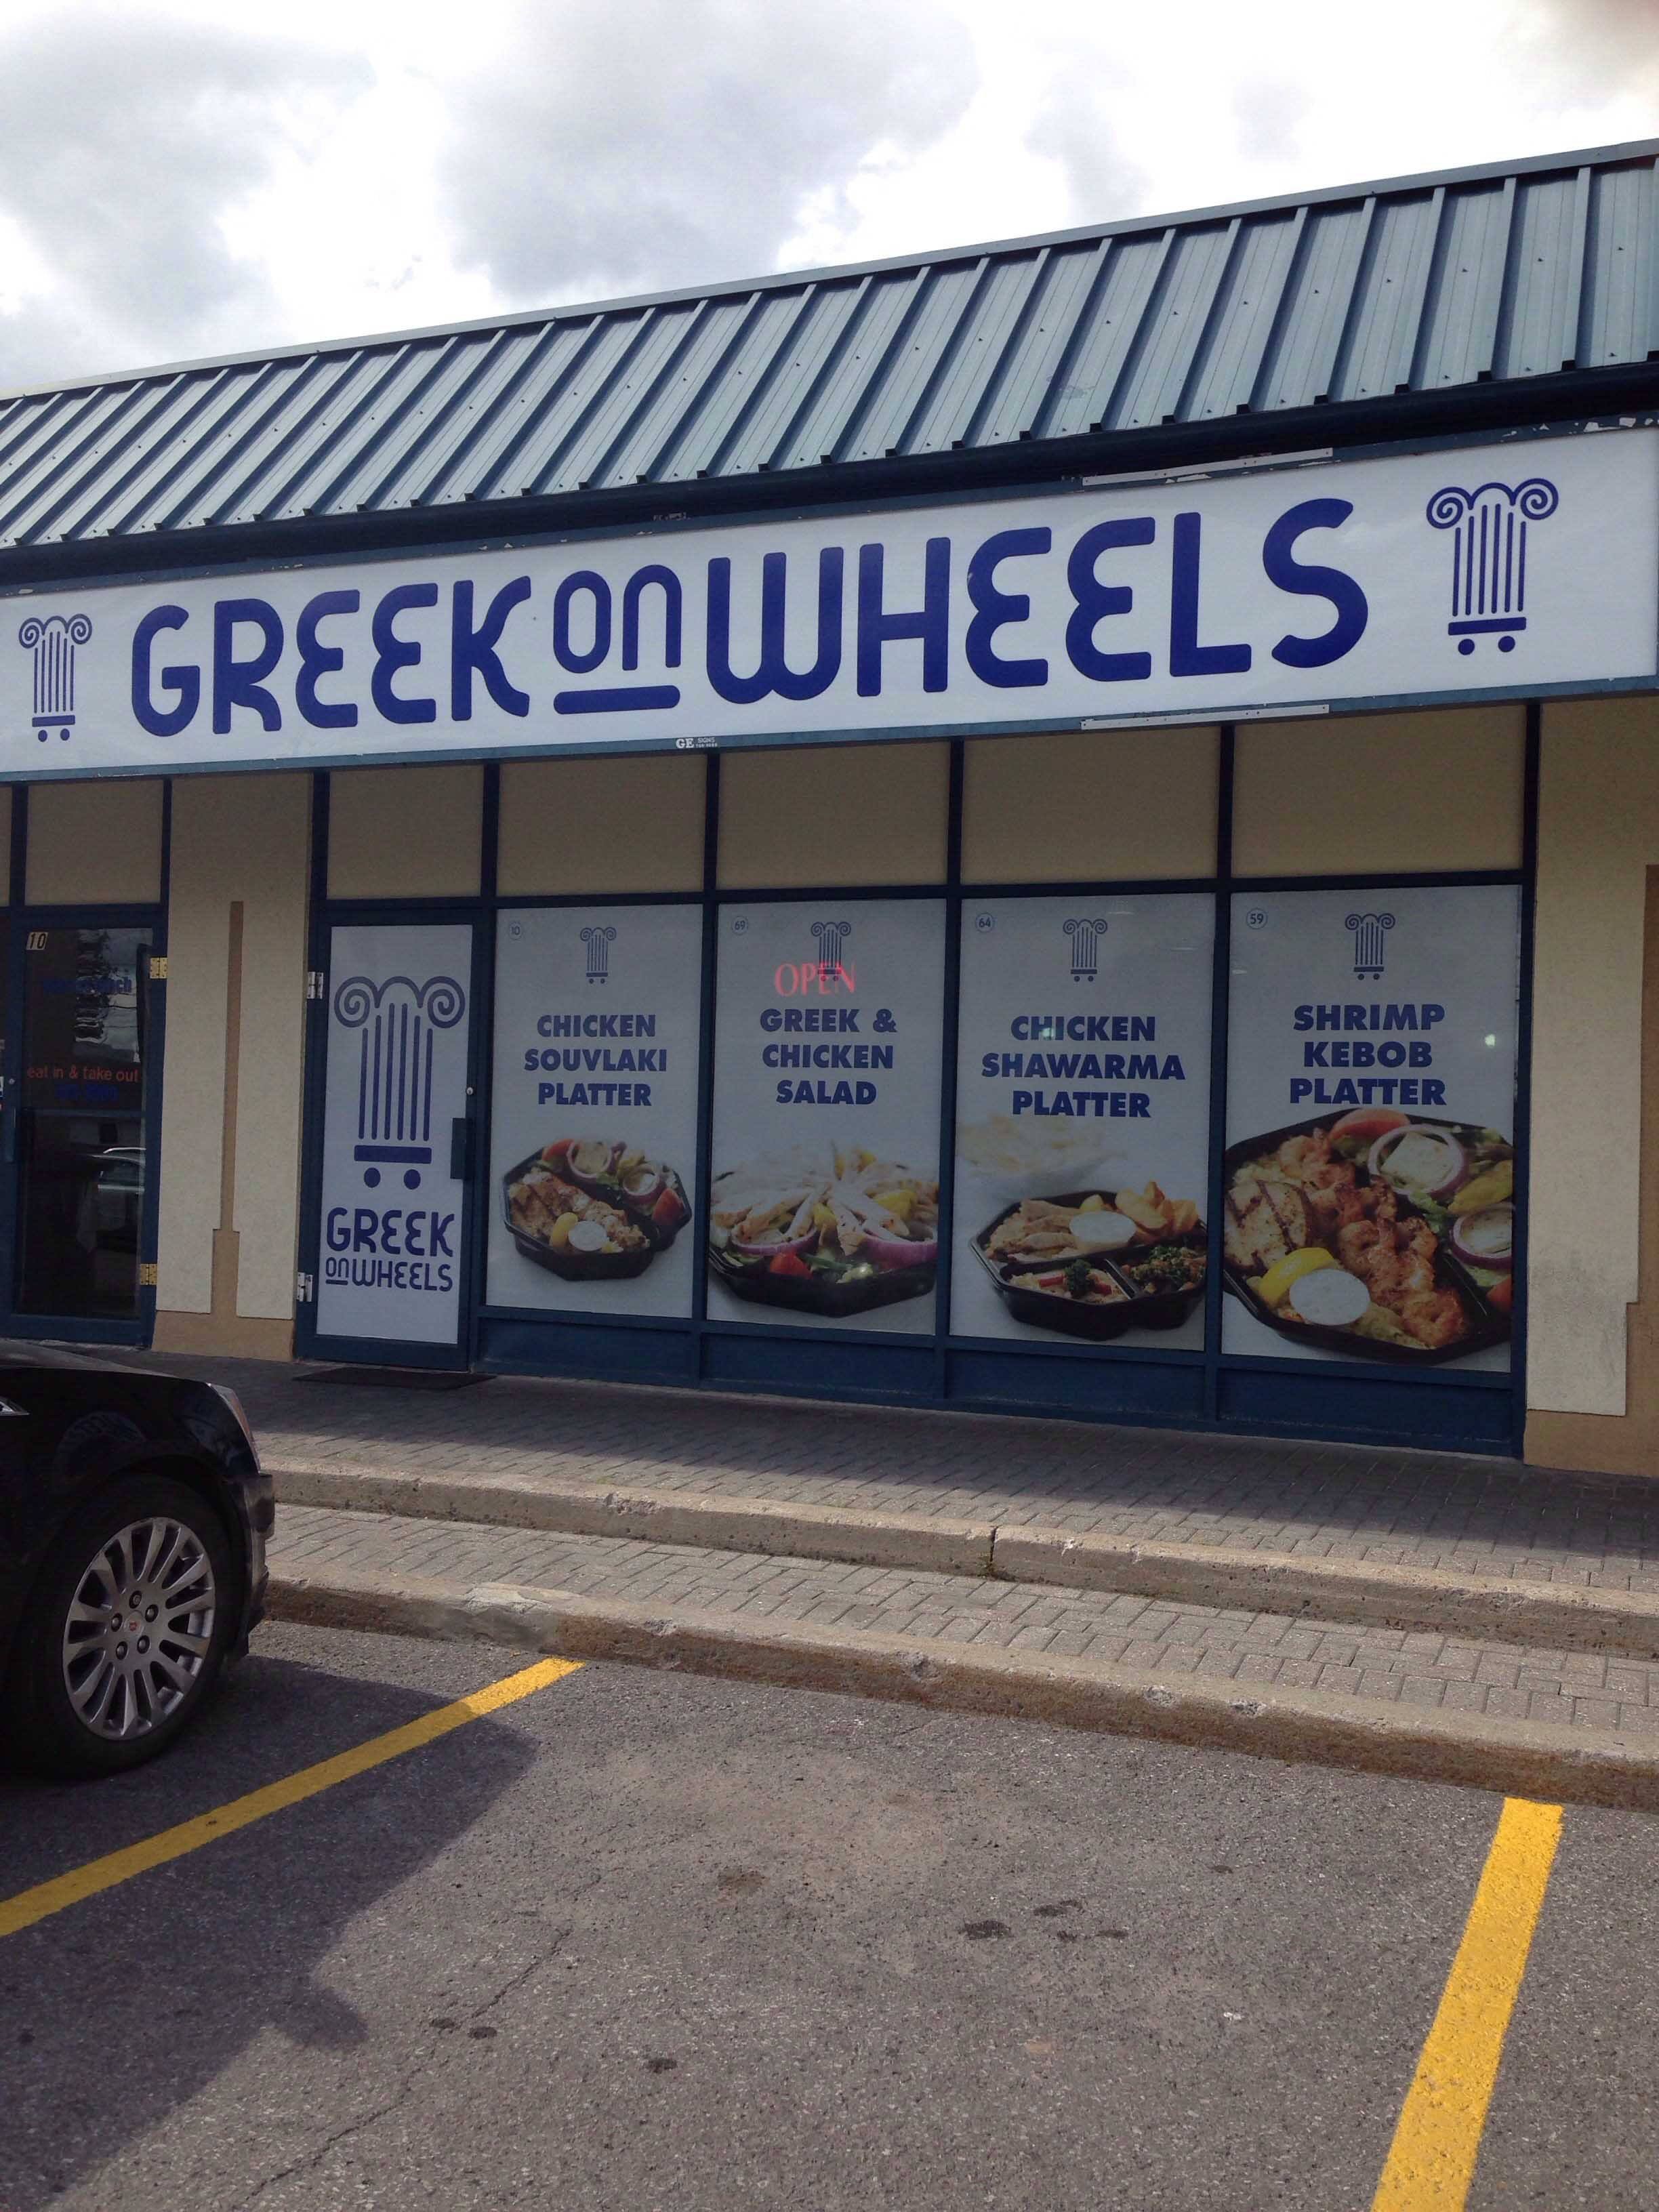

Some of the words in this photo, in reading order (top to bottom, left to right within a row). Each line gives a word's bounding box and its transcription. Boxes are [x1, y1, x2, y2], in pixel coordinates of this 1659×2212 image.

[131, 575, 531, 737] GREEK
[706, 497, 1368, 703] WHEELS
[676, 738, 694, 749] GE
[735, 920, 745, 931] 69
[979, 917, 991, 928] 64
[1249, 914, 1263, 925] 59
[30, 933, 46, 949] 10
[775, 962, 856, 996] OPEN
[537, 1015, 656, 1038] CHICKEN
[760, 1008, 860, 1032] GREEK
[873, 1008, 898, 1032] &
[1010, 1016, 1155, 1041] CHICKEN
[1293, 1004, 1445, 1031] SHRIMP
[524, 1048, 668, 1072] SOUVLAKI
[762, 1044, 893, 1069] CHICKEN
[982, 1052, 1185, 1080] SHAWARMA
[1304, 1041, 1433, 1067] KEBOB
[27, 1065, 49, 1079] eat
[83, 1065, 112, 1081] take
[115, 1068, 140, 1083] out
[538, 1083, 652, 1106] PLATTER
[776, 1080, 877, 1105] SALAD
[1012, 1090, 1151, 1118] PLATTER
[1290, 1078, 1447, 1105] PLATTER
[327, 1207, 455, 1257] GREEK
[352, 1258, 453, 1292] WHEELS
